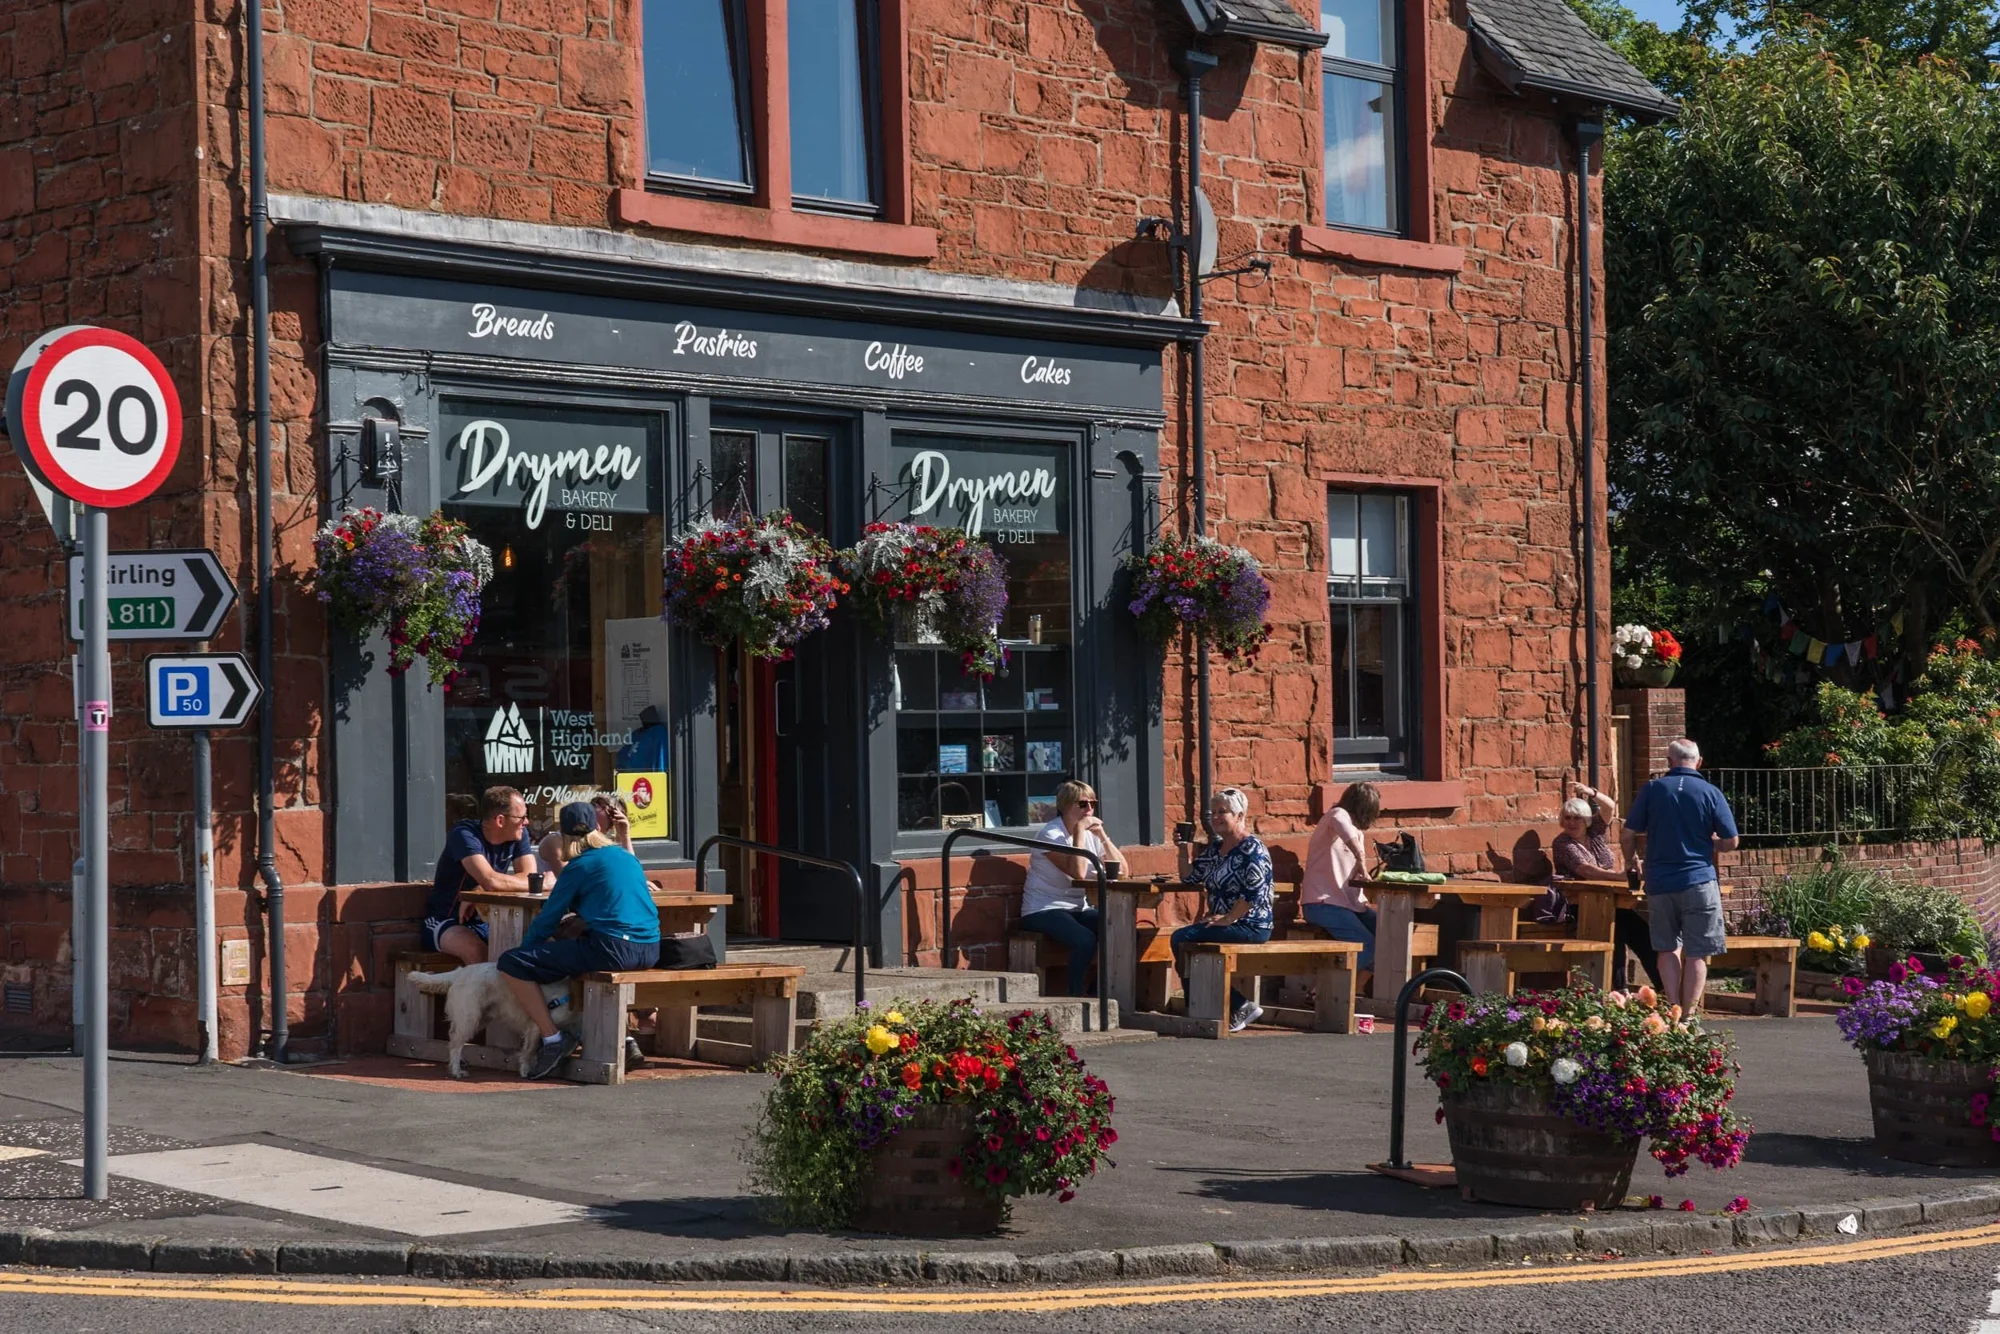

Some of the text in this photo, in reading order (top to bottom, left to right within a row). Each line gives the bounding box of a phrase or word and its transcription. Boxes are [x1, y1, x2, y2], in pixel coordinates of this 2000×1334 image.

[468, 303, 1072, 385] Breads Pastries Coffee Cakes
[54, 378, 158, 456] 20
[460, 420, 641, 530] Drymen
[561, 489, 618, 508] BAKERY
[910, 451, 1057, 538] Drymen
[566, 512, 613, 531] & DELI
[993, 508, 1039, 523] BAKERY
[997, 529, 1035, 544] & DELI
[80, 564, 175, 587] irling
[167, 672, 198, 711] P
[182, 699, 202, 711] 50
[550, 710, 596, 727] West
[551, 728, 633, 752] Highland
[483, 742, 534, 774] WHW
[551, 750, 592, 770] Way
